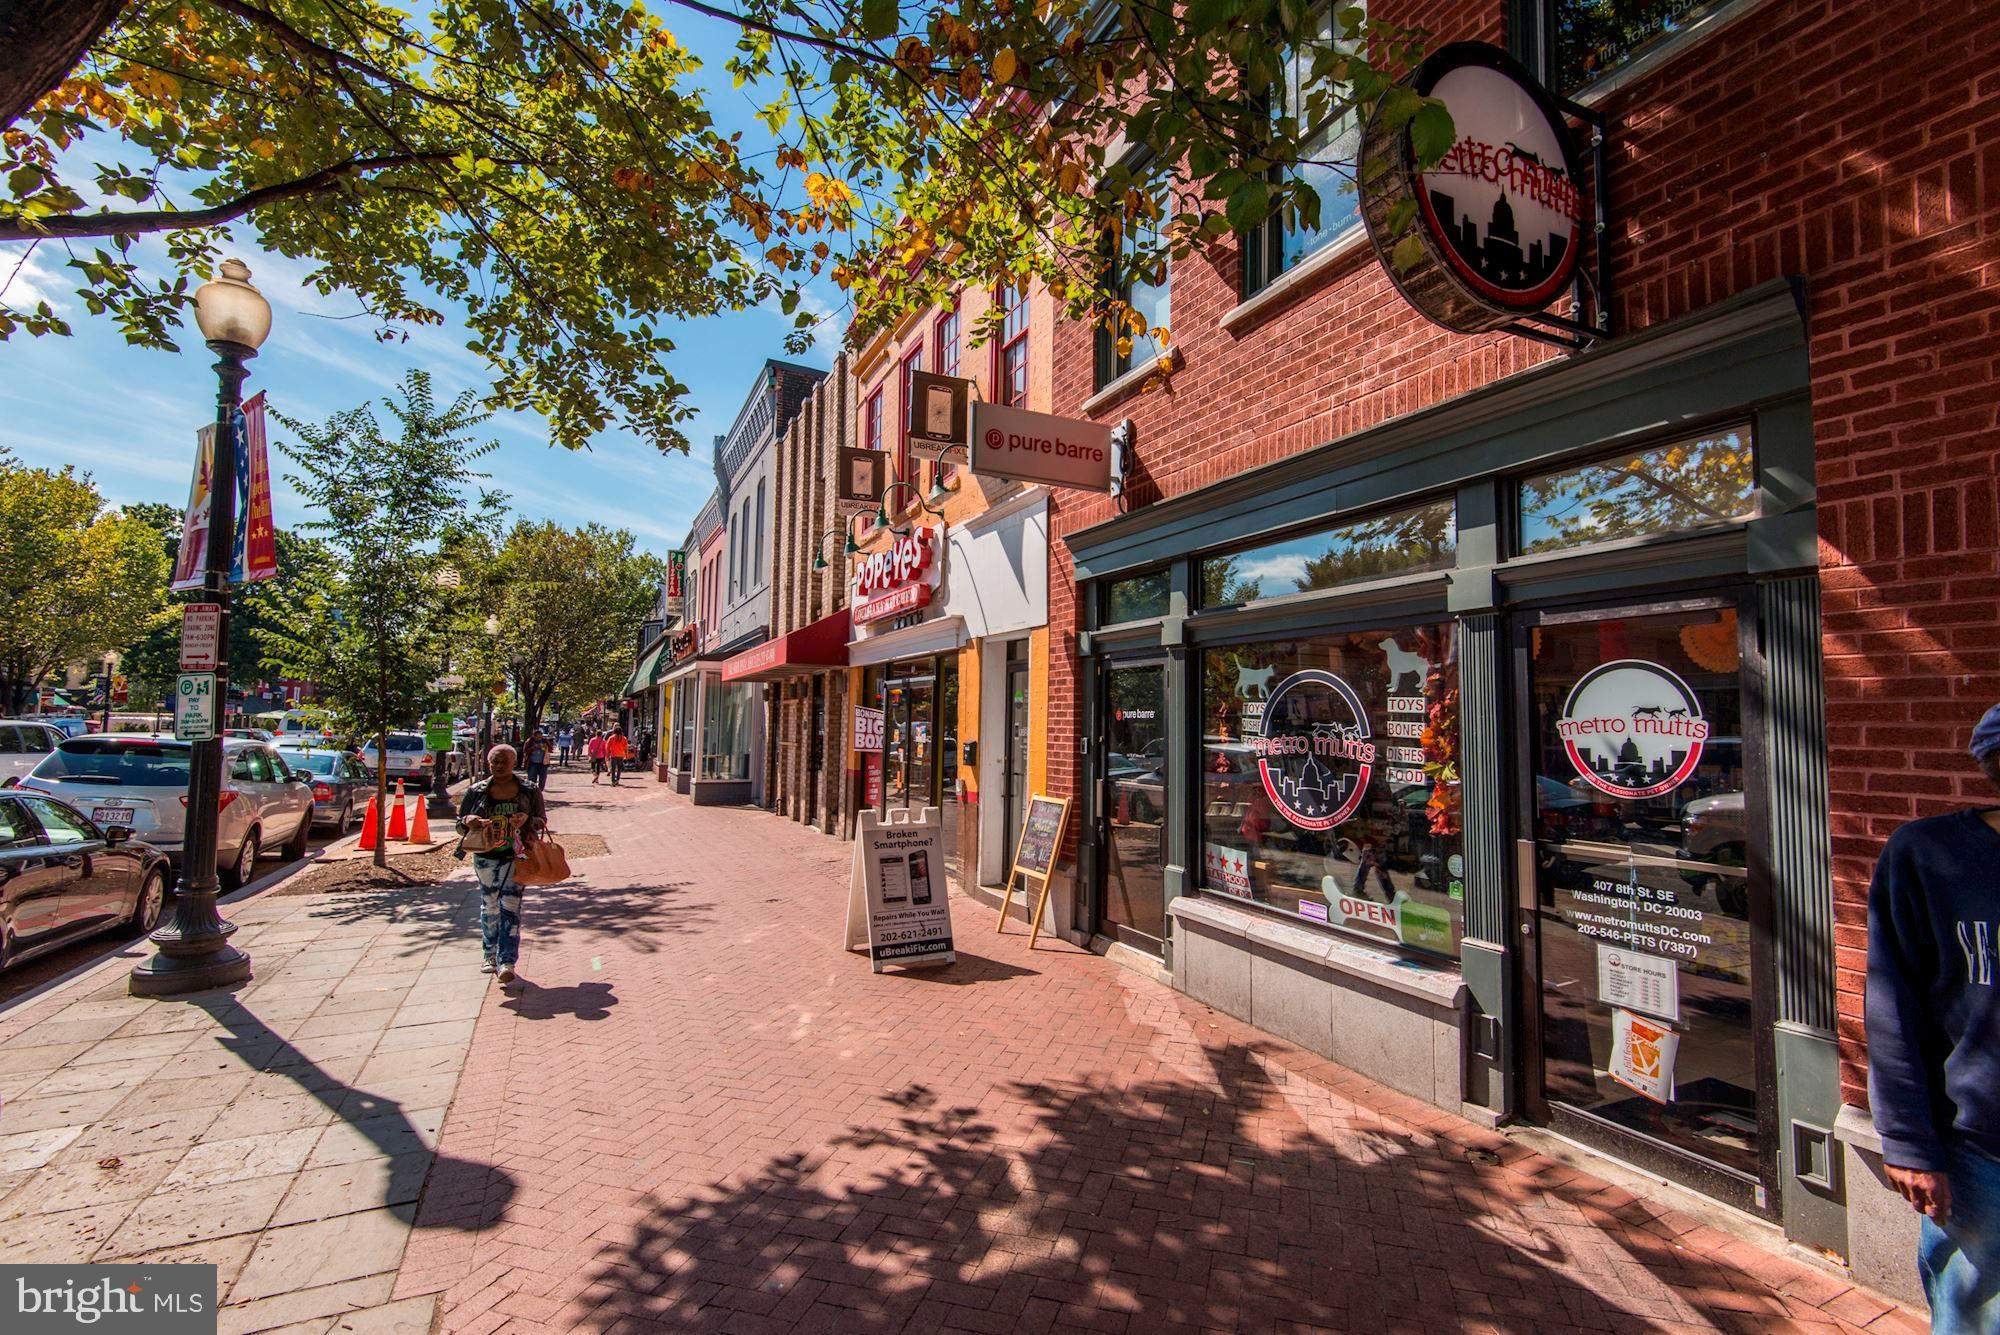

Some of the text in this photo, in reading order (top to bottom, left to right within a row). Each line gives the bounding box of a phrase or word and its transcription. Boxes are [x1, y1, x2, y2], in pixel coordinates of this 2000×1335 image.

[1600, 41, 1617, 62] lift
[1626, 17, 1661, 45] tone
[1332, 213, 1352, 232] burn
[1008, 434, 1052, 453] pure
[1055, 438, 1104, 462] barre
[1244, 704, 1265, 714] TOYS
[1388, 699, 1424, 712] TOYS
[1122, 710, 1136, 720] pure
[855, 718, 884, 735] BIG
[1388, 722, 1424, 737] BONES
[1559, 716, 1707, 739] metro mutts
[855, 733, 884, 749] BOX
[1255, 733, 1376, 763] metro mutts
[1387, 747, 1424, 762] DISHES
[1387, 768, 1423, 783] FOOD
[1586, 772, 1680, 797] FOR THE PASSIONATE PET OWNER
[1274, 798, 1283, 810] FOR
[1283, 808, 1292, 818] THE
[1291, 814, 1322, 827] PASSIONATE
[1334, 806, 1351, 822] OWNER
[886, 830, 918, 839] Broken
[874, 838, 933, 850] Smartphone?
[1593, 880, 1675, 902] 407 8th St. SE
[1339, 898, 1397, 926] OPEN
[1571, 889, 1703, 921] Washington, DC 20003
[873, 912, 898, 922] Repairs
[898, 910, 916, 919] While
[880, 927, 943, 942] 202-621-2491
[1566, 909, 1711, 944] www.metromuttsDC.com
[880, 942, 946, 957] uBreakiFix.com
[1577, 923, 1698, 959] 202-546-PETS (7387)
[1956, 920, 2000, 986] SE
[1621, 963, 1667, 979] STORE HOURS
